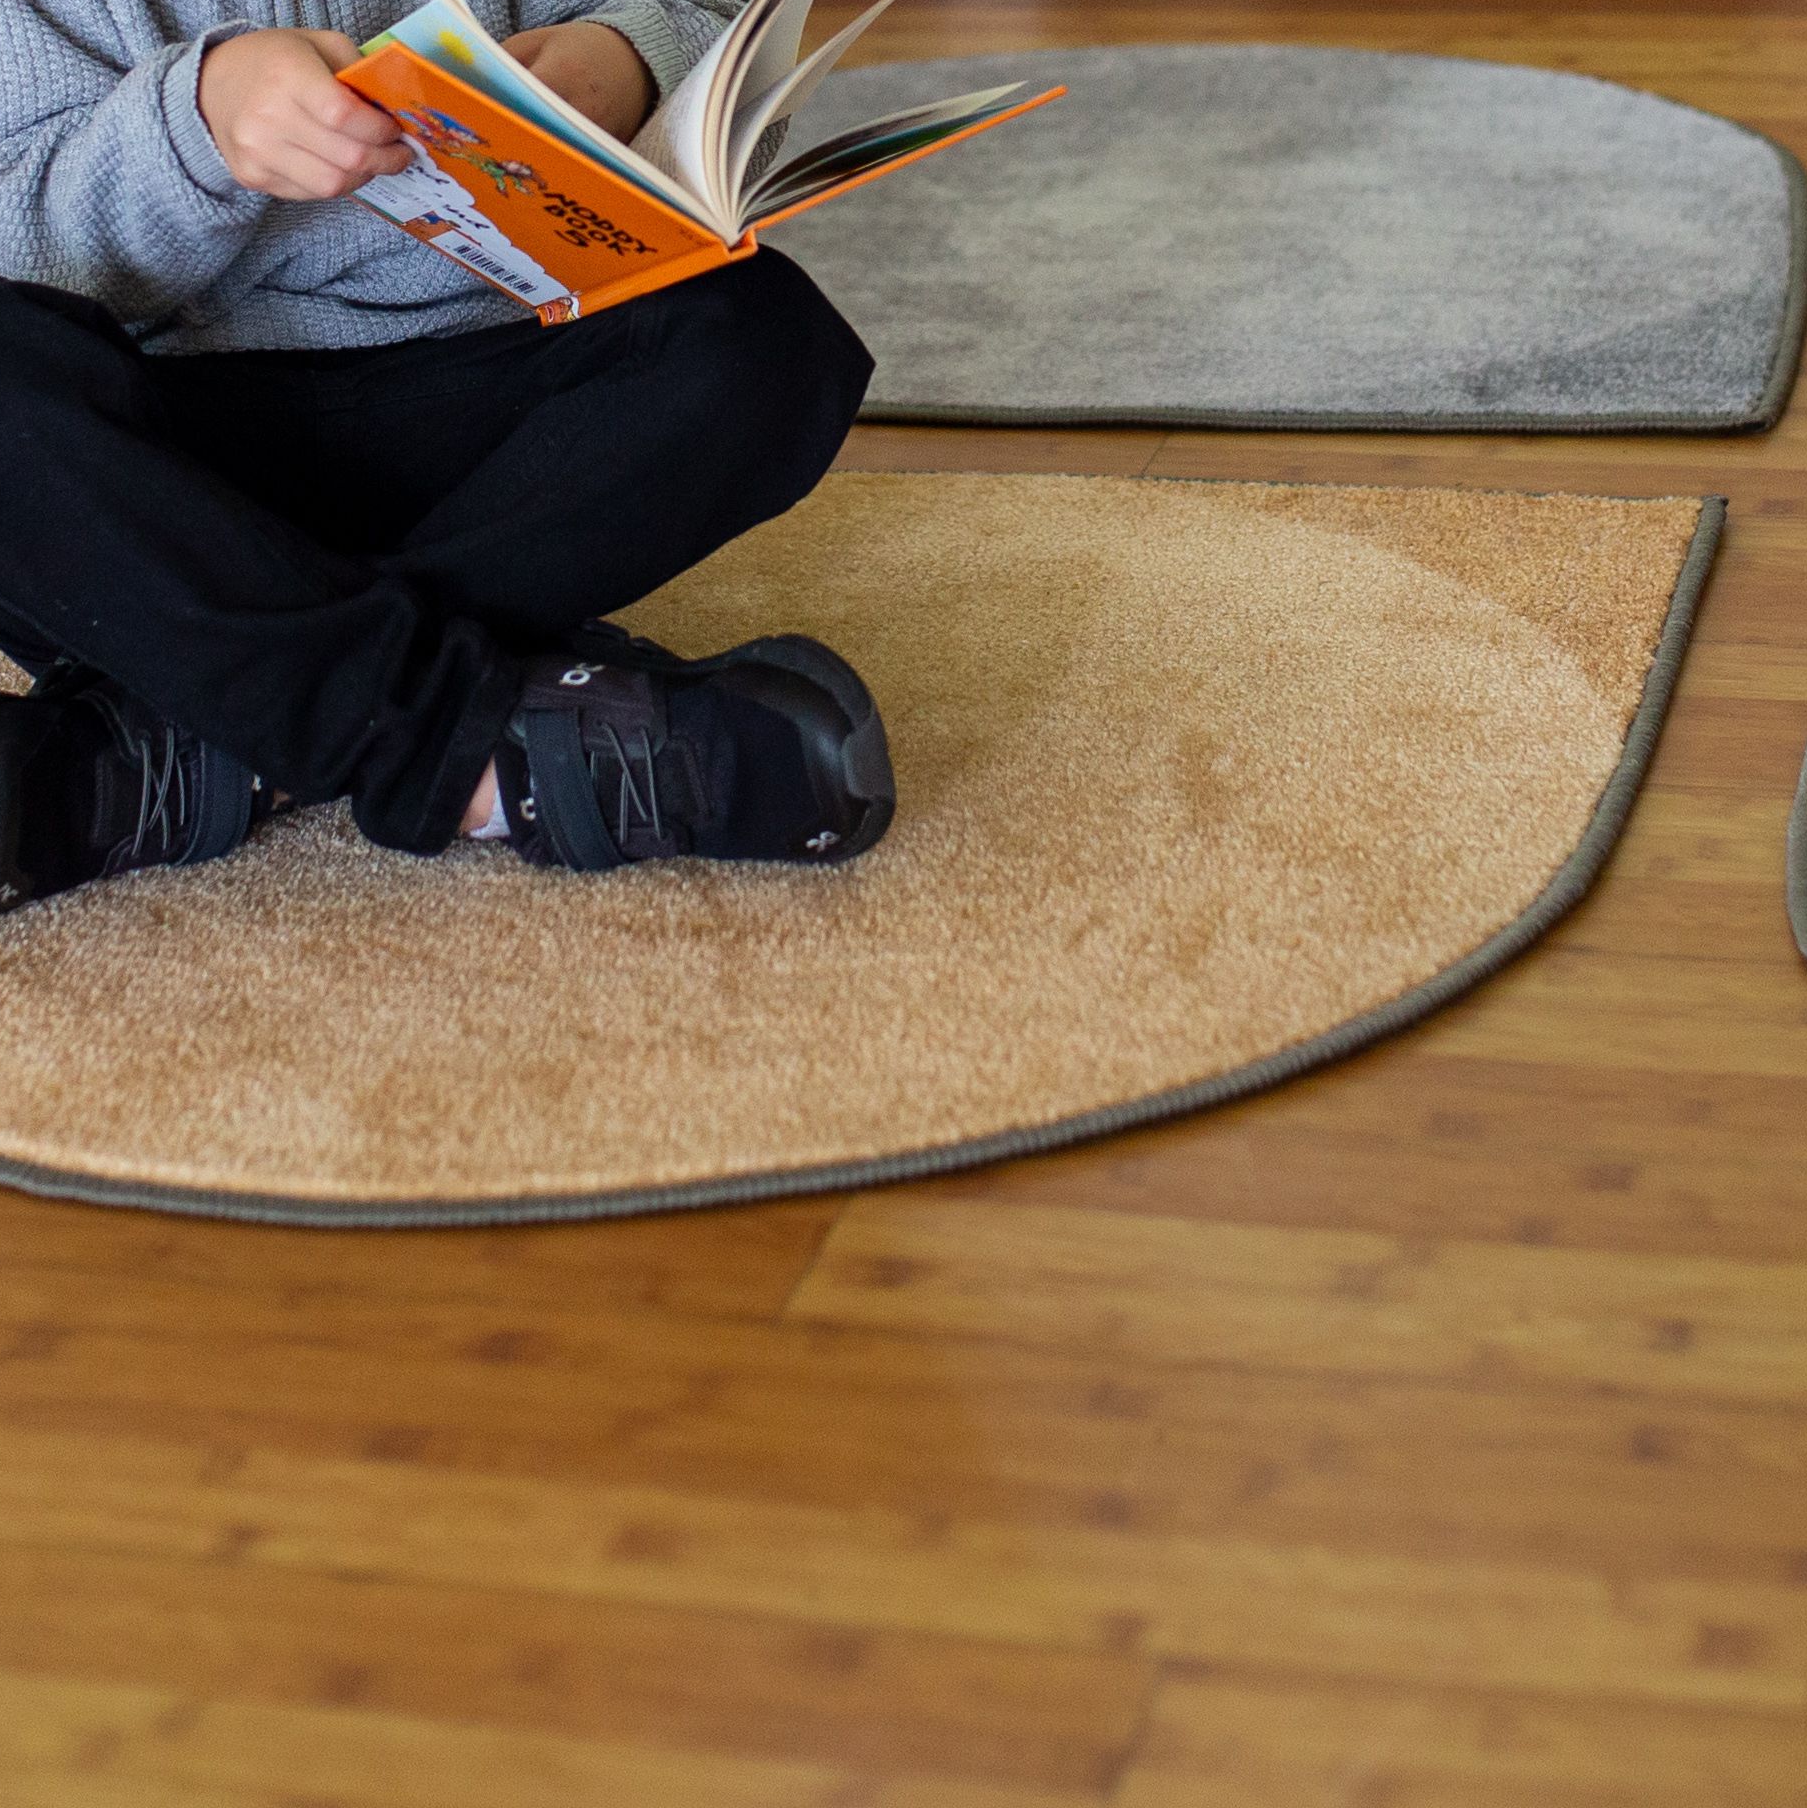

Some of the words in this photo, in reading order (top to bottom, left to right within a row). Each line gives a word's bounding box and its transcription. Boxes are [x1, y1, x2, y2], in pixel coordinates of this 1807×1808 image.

[544, 192, 658, 254] NODDY
[544, 204, 630, 256] BOOK
[554, 228, 590, 248] 5
